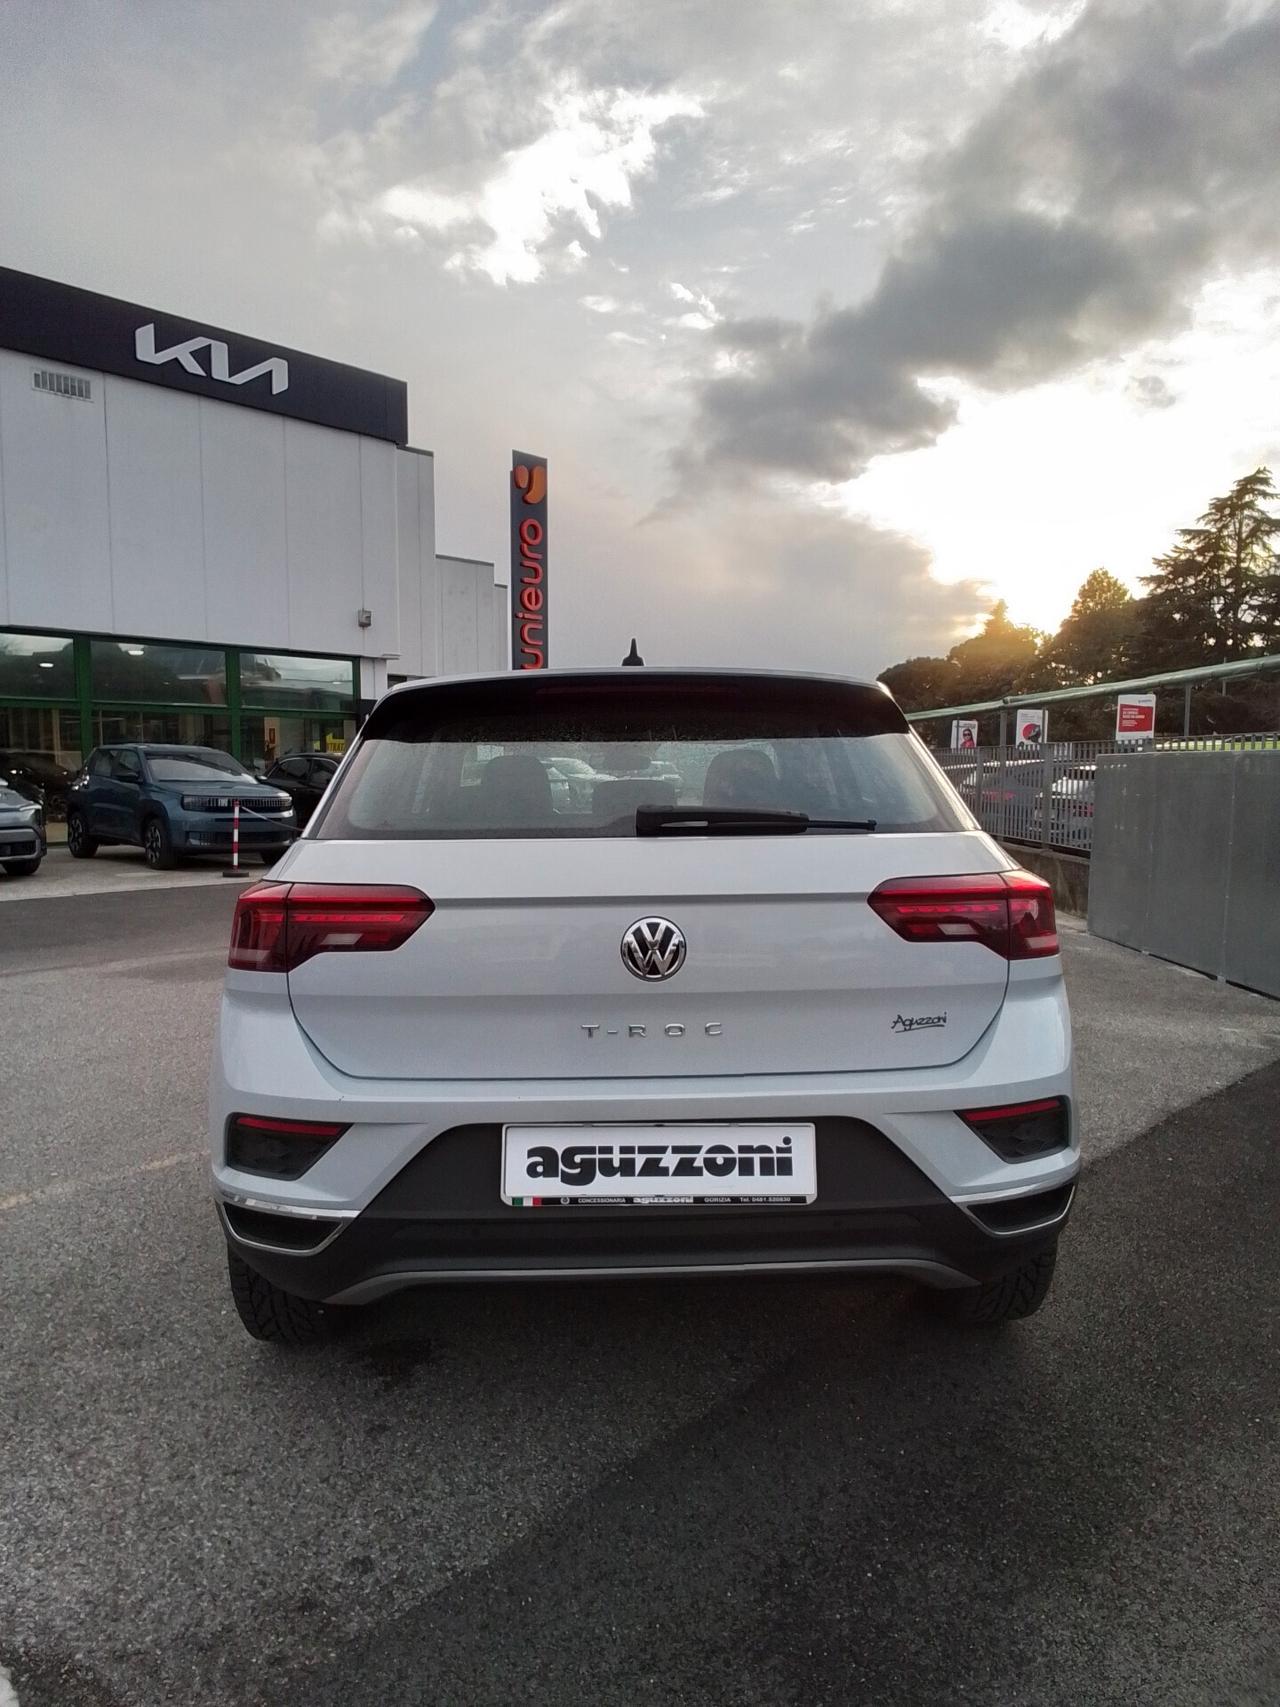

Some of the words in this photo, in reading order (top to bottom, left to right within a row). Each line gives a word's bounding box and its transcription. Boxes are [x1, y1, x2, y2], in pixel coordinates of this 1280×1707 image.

[515, 518, 544, 669] unieuro
[891, 1011, 948, 1032] Aguzzoni
[525, 1136, 793, 1187] aguzzoni
